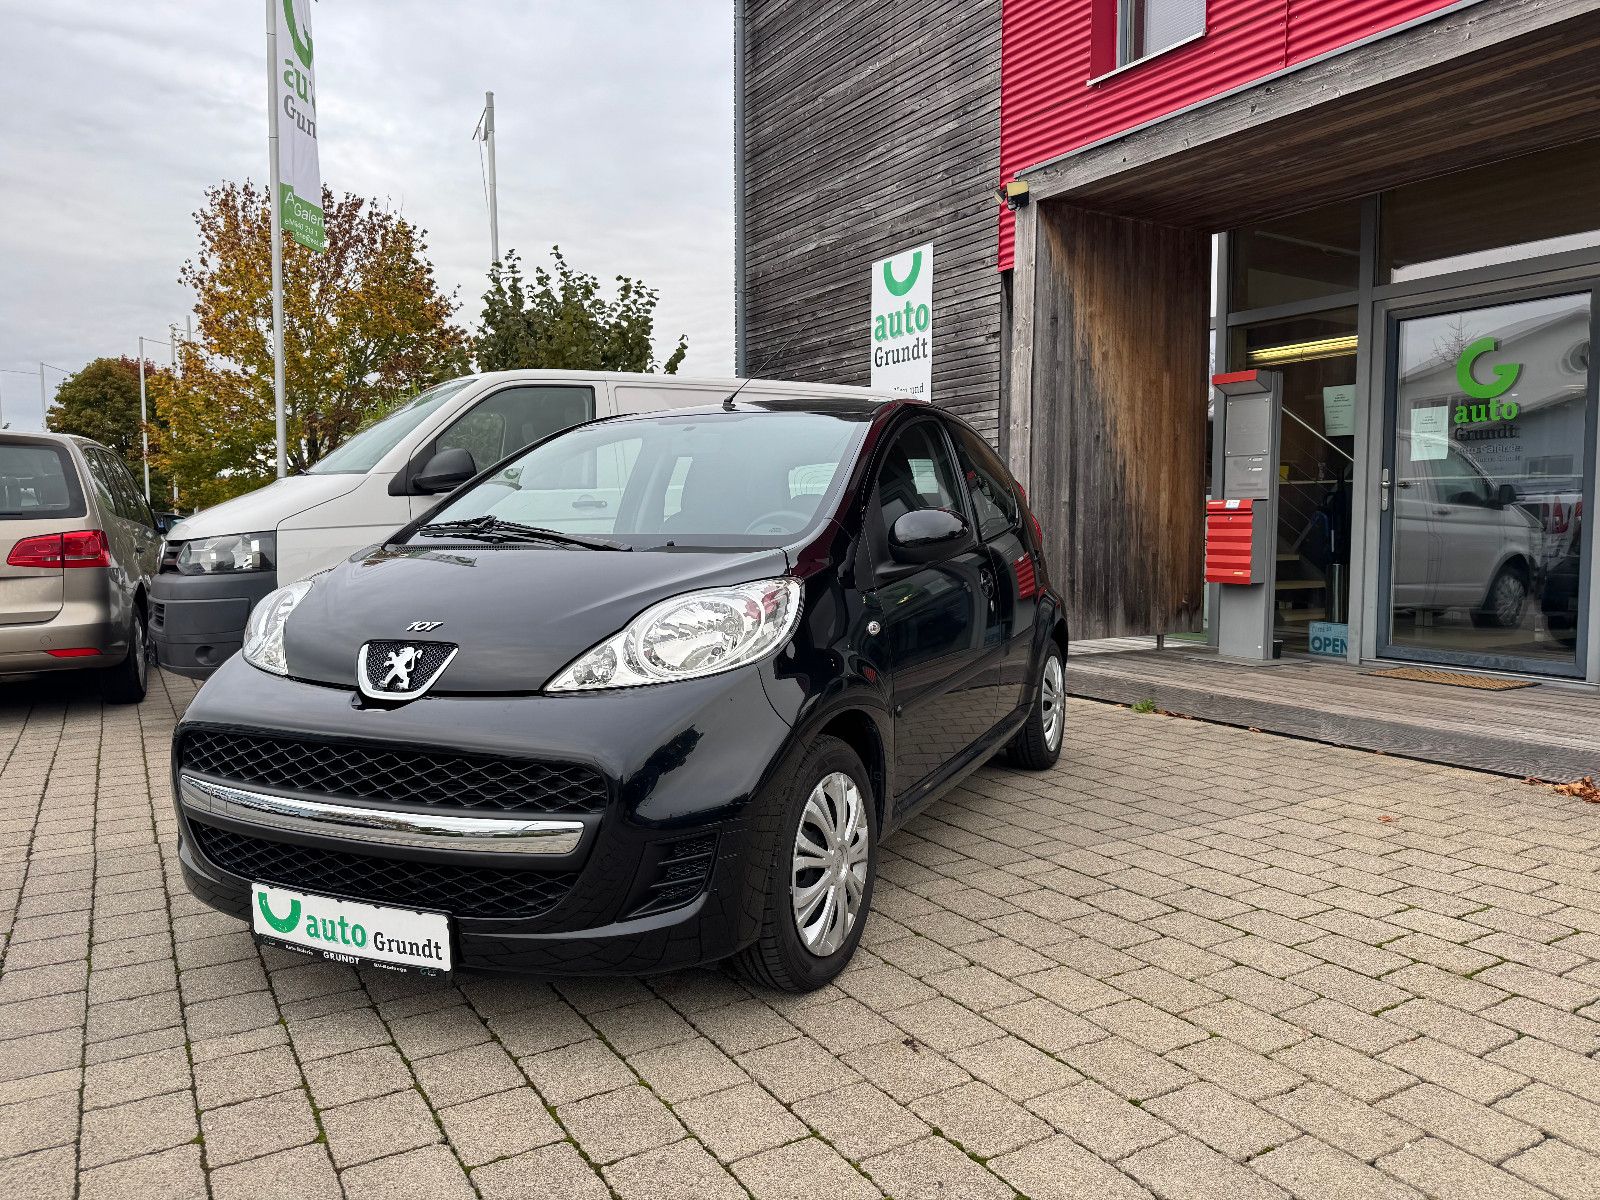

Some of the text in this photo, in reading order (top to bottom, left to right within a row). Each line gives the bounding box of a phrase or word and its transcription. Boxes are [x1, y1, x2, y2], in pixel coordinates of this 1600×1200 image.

[874, 300, 930, 343] auto
[874, 337, 928, 368] Grundt
[1453, 398, 1519, 424] auto
[1454, 425, 1520, 441] Grundt
[406, 621, 443, 632] 107
[1311, 636, 1347, 653] OPEN
[306, 914, 443, 961] auto Grundt
[323, 951, 360, 965] GRUNDT
